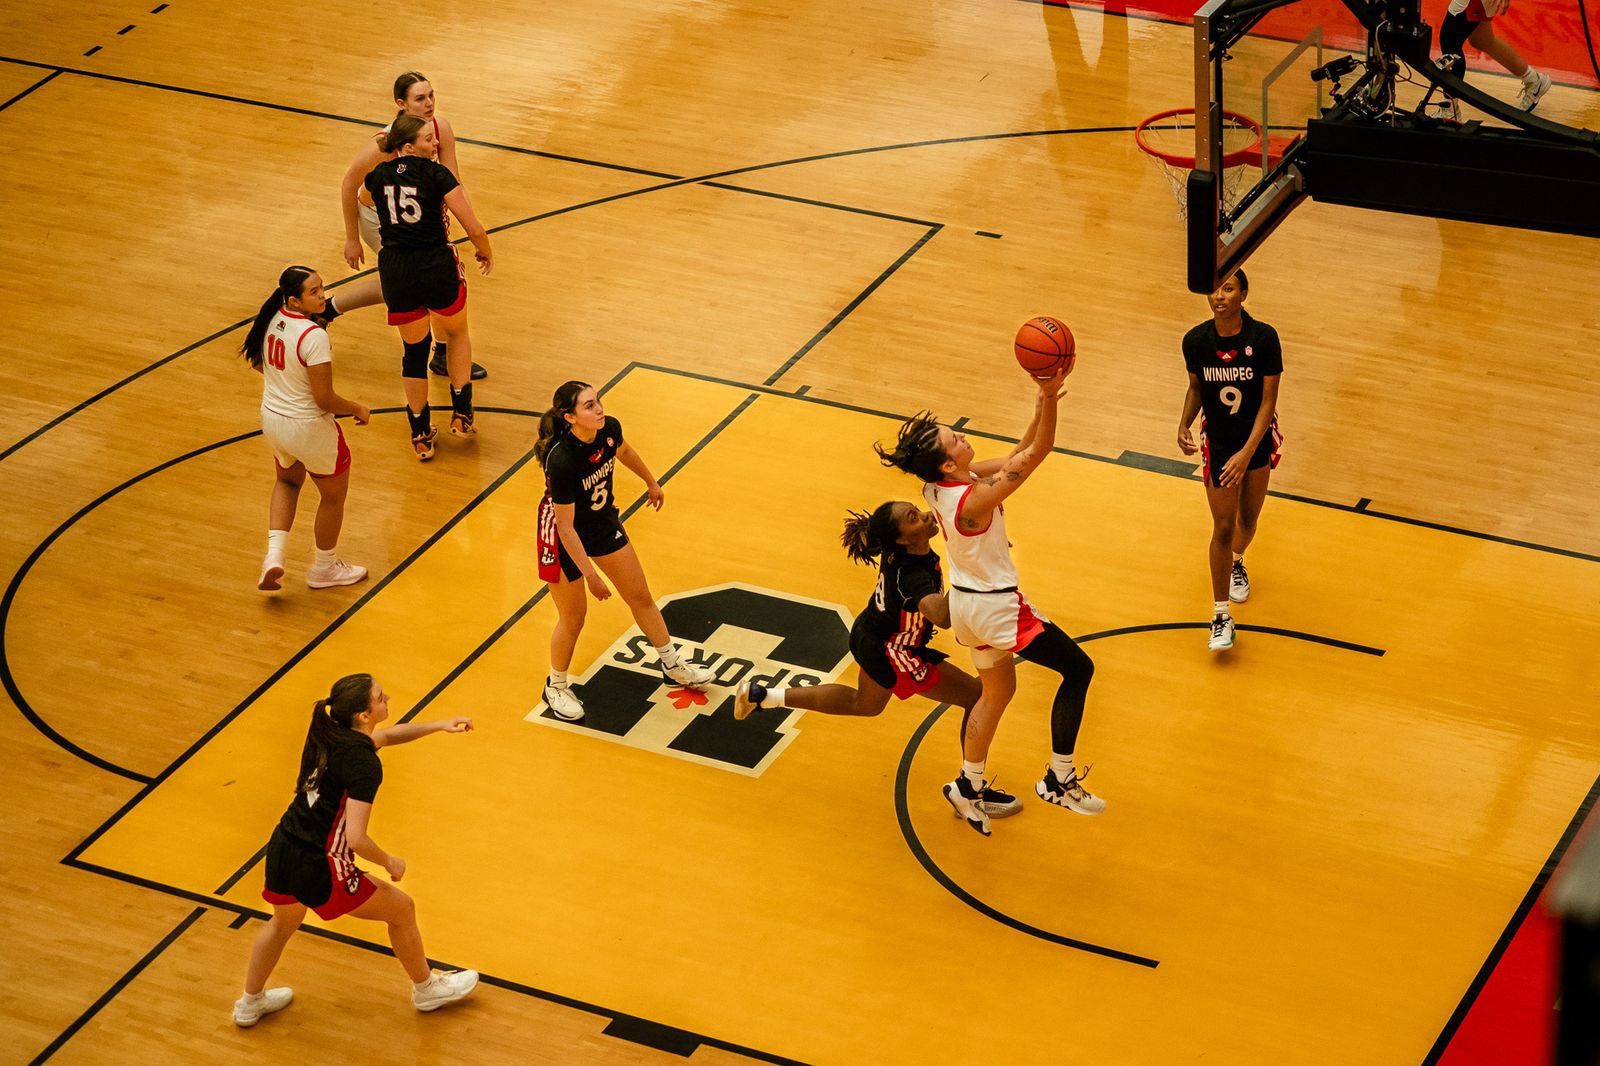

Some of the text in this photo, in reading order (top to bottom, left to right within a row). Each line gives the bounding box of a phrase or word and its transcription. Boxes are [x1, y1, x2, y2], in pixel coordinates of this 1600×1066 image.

[383, 185, 422, 225] 15
[267, 334, 286, 371] 10
[1203, 366, 1254, 382] WINNIPEG
[1219, 385, 1243, 415] 9
[590, 480, 608, 511] 5
